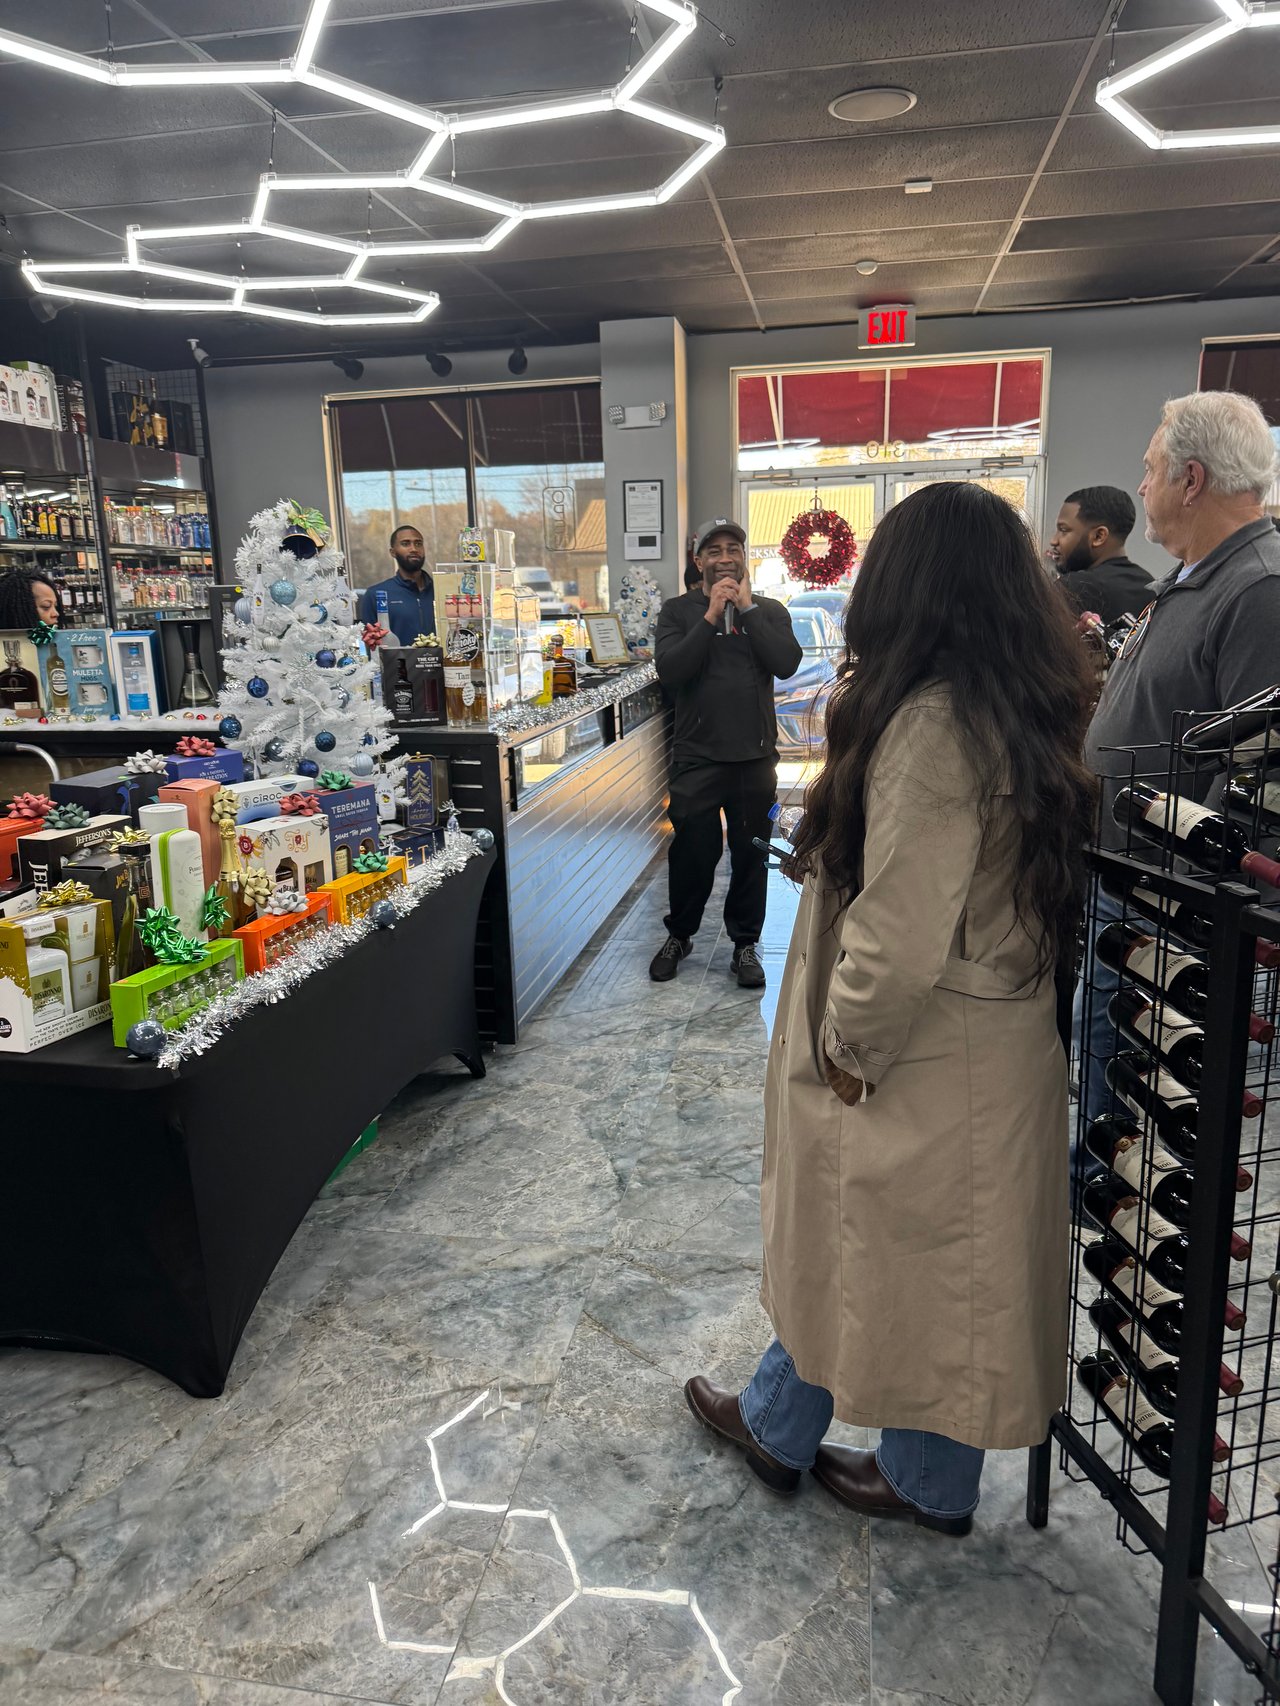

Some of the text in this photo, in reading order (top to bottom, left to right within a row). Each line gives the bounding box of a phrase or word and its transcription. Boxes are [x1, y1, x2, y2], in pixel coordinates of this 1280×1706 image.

[867, 310, 908, 344] EXIT
[70, 632, 98, 642] 2 Free
[331, 798, 371, 815] TEREMANA
[75, 828, 112, 847] JEFFERSON'S
[34, 985, 62, 1000] DISARONNO
[30, 1021, 85, 1047] PERFECT OVER ICE
